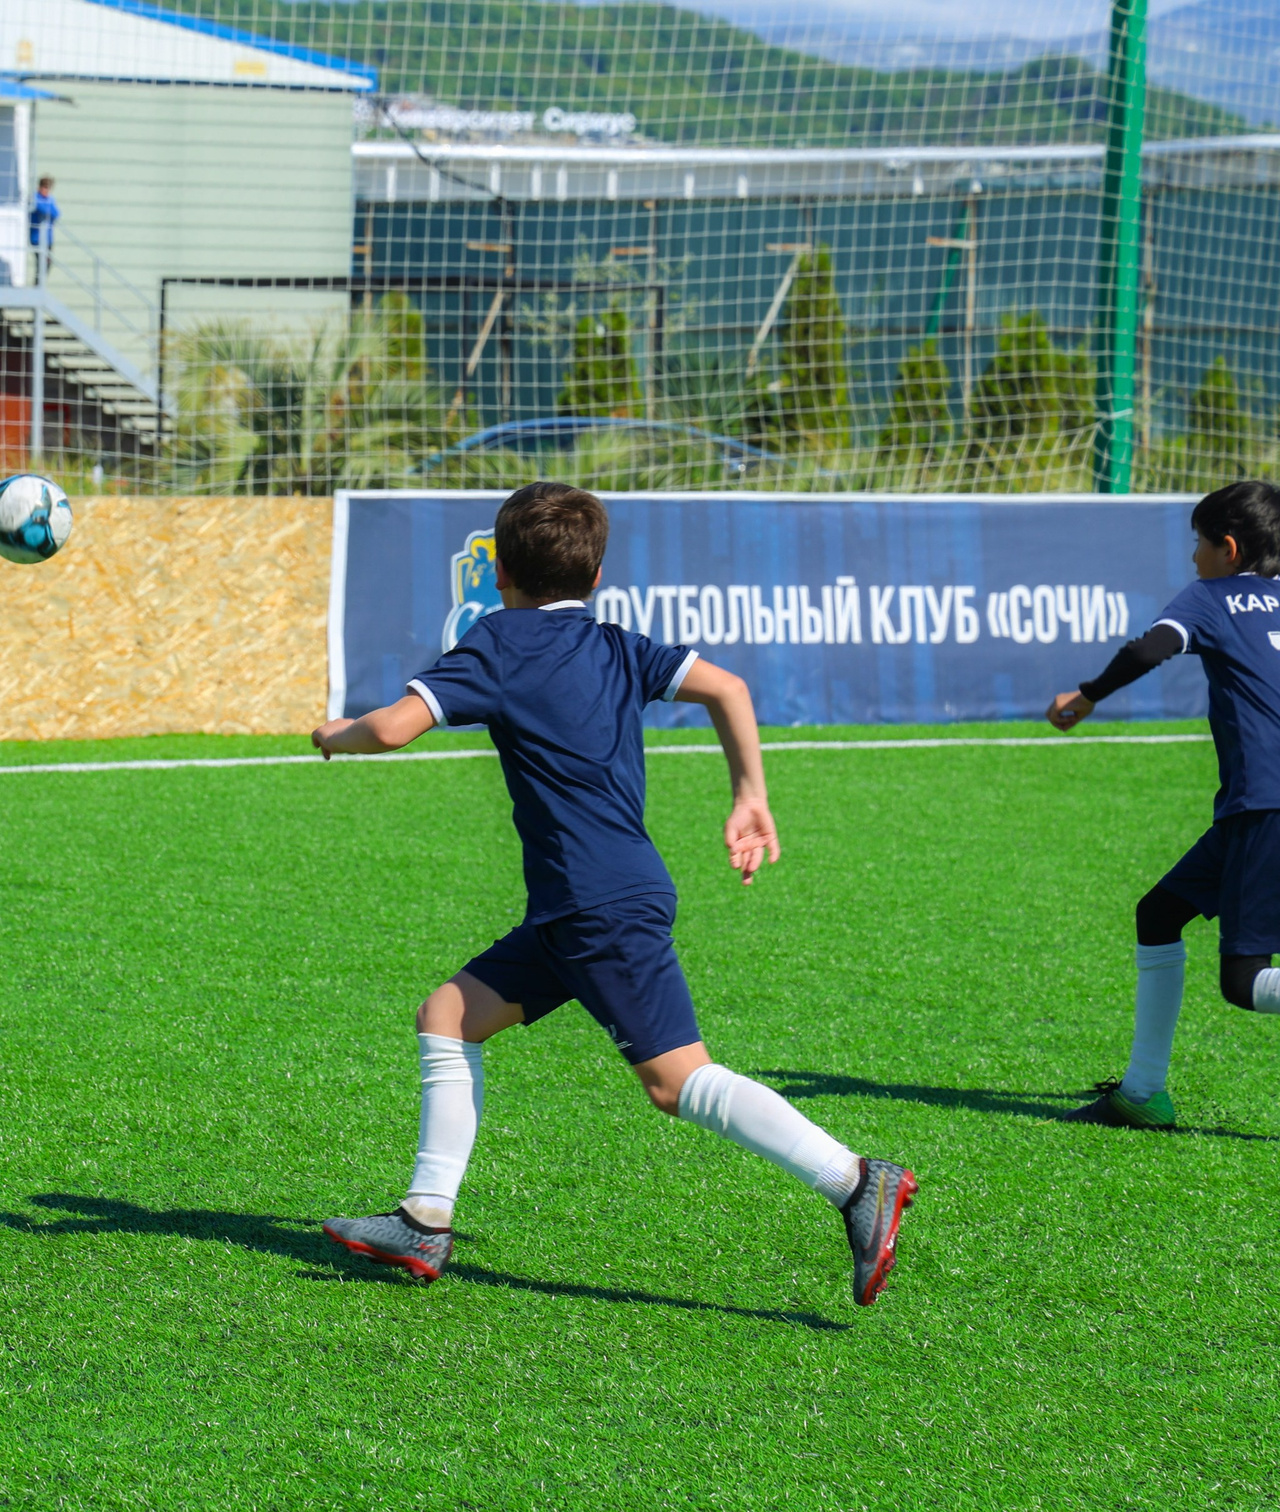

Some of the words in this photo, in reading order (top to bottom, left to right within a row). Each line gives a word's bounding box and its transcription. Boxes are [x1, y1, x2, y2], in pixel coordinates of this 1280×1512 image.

[595, 576, 863, 645] ФУТБОЛЬНЫЙ
[869, 585, 981, 645] КЛУБ
[986, 584, 1130, 645] «СОЧИ»
